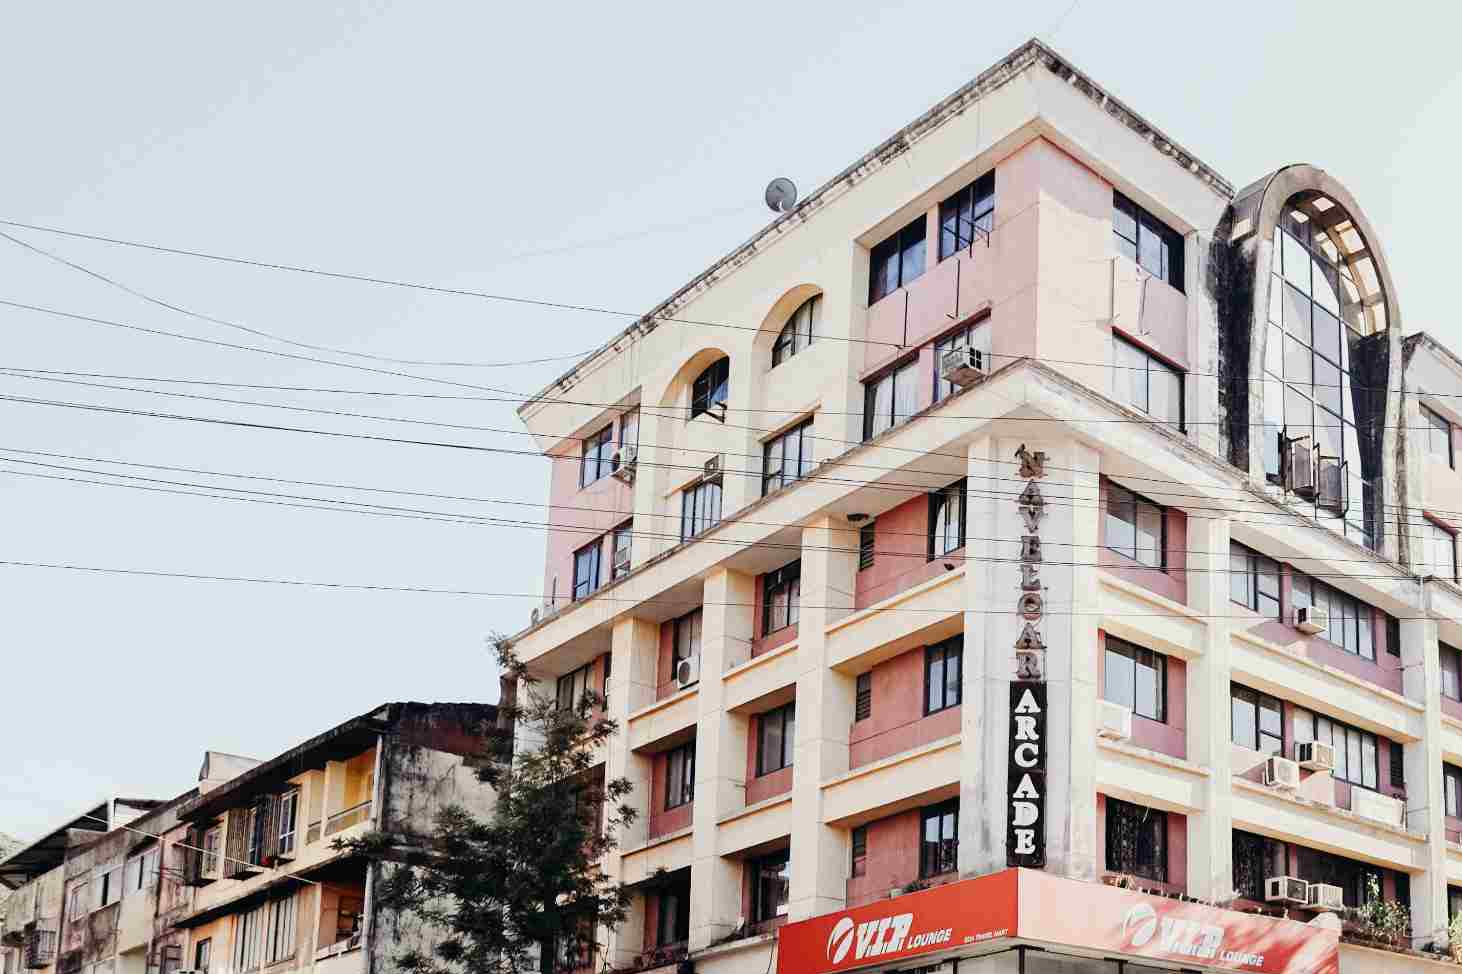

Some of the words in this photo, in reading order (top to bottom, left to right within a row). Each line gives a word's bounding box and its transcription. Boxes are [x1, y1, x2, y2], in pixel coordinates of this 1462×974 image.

[1012, 688, 1042, 855] ARCADE
[906, 927, 953, 950] LOUNGE
[1218, 950, 1265, 967] LOUNGE
